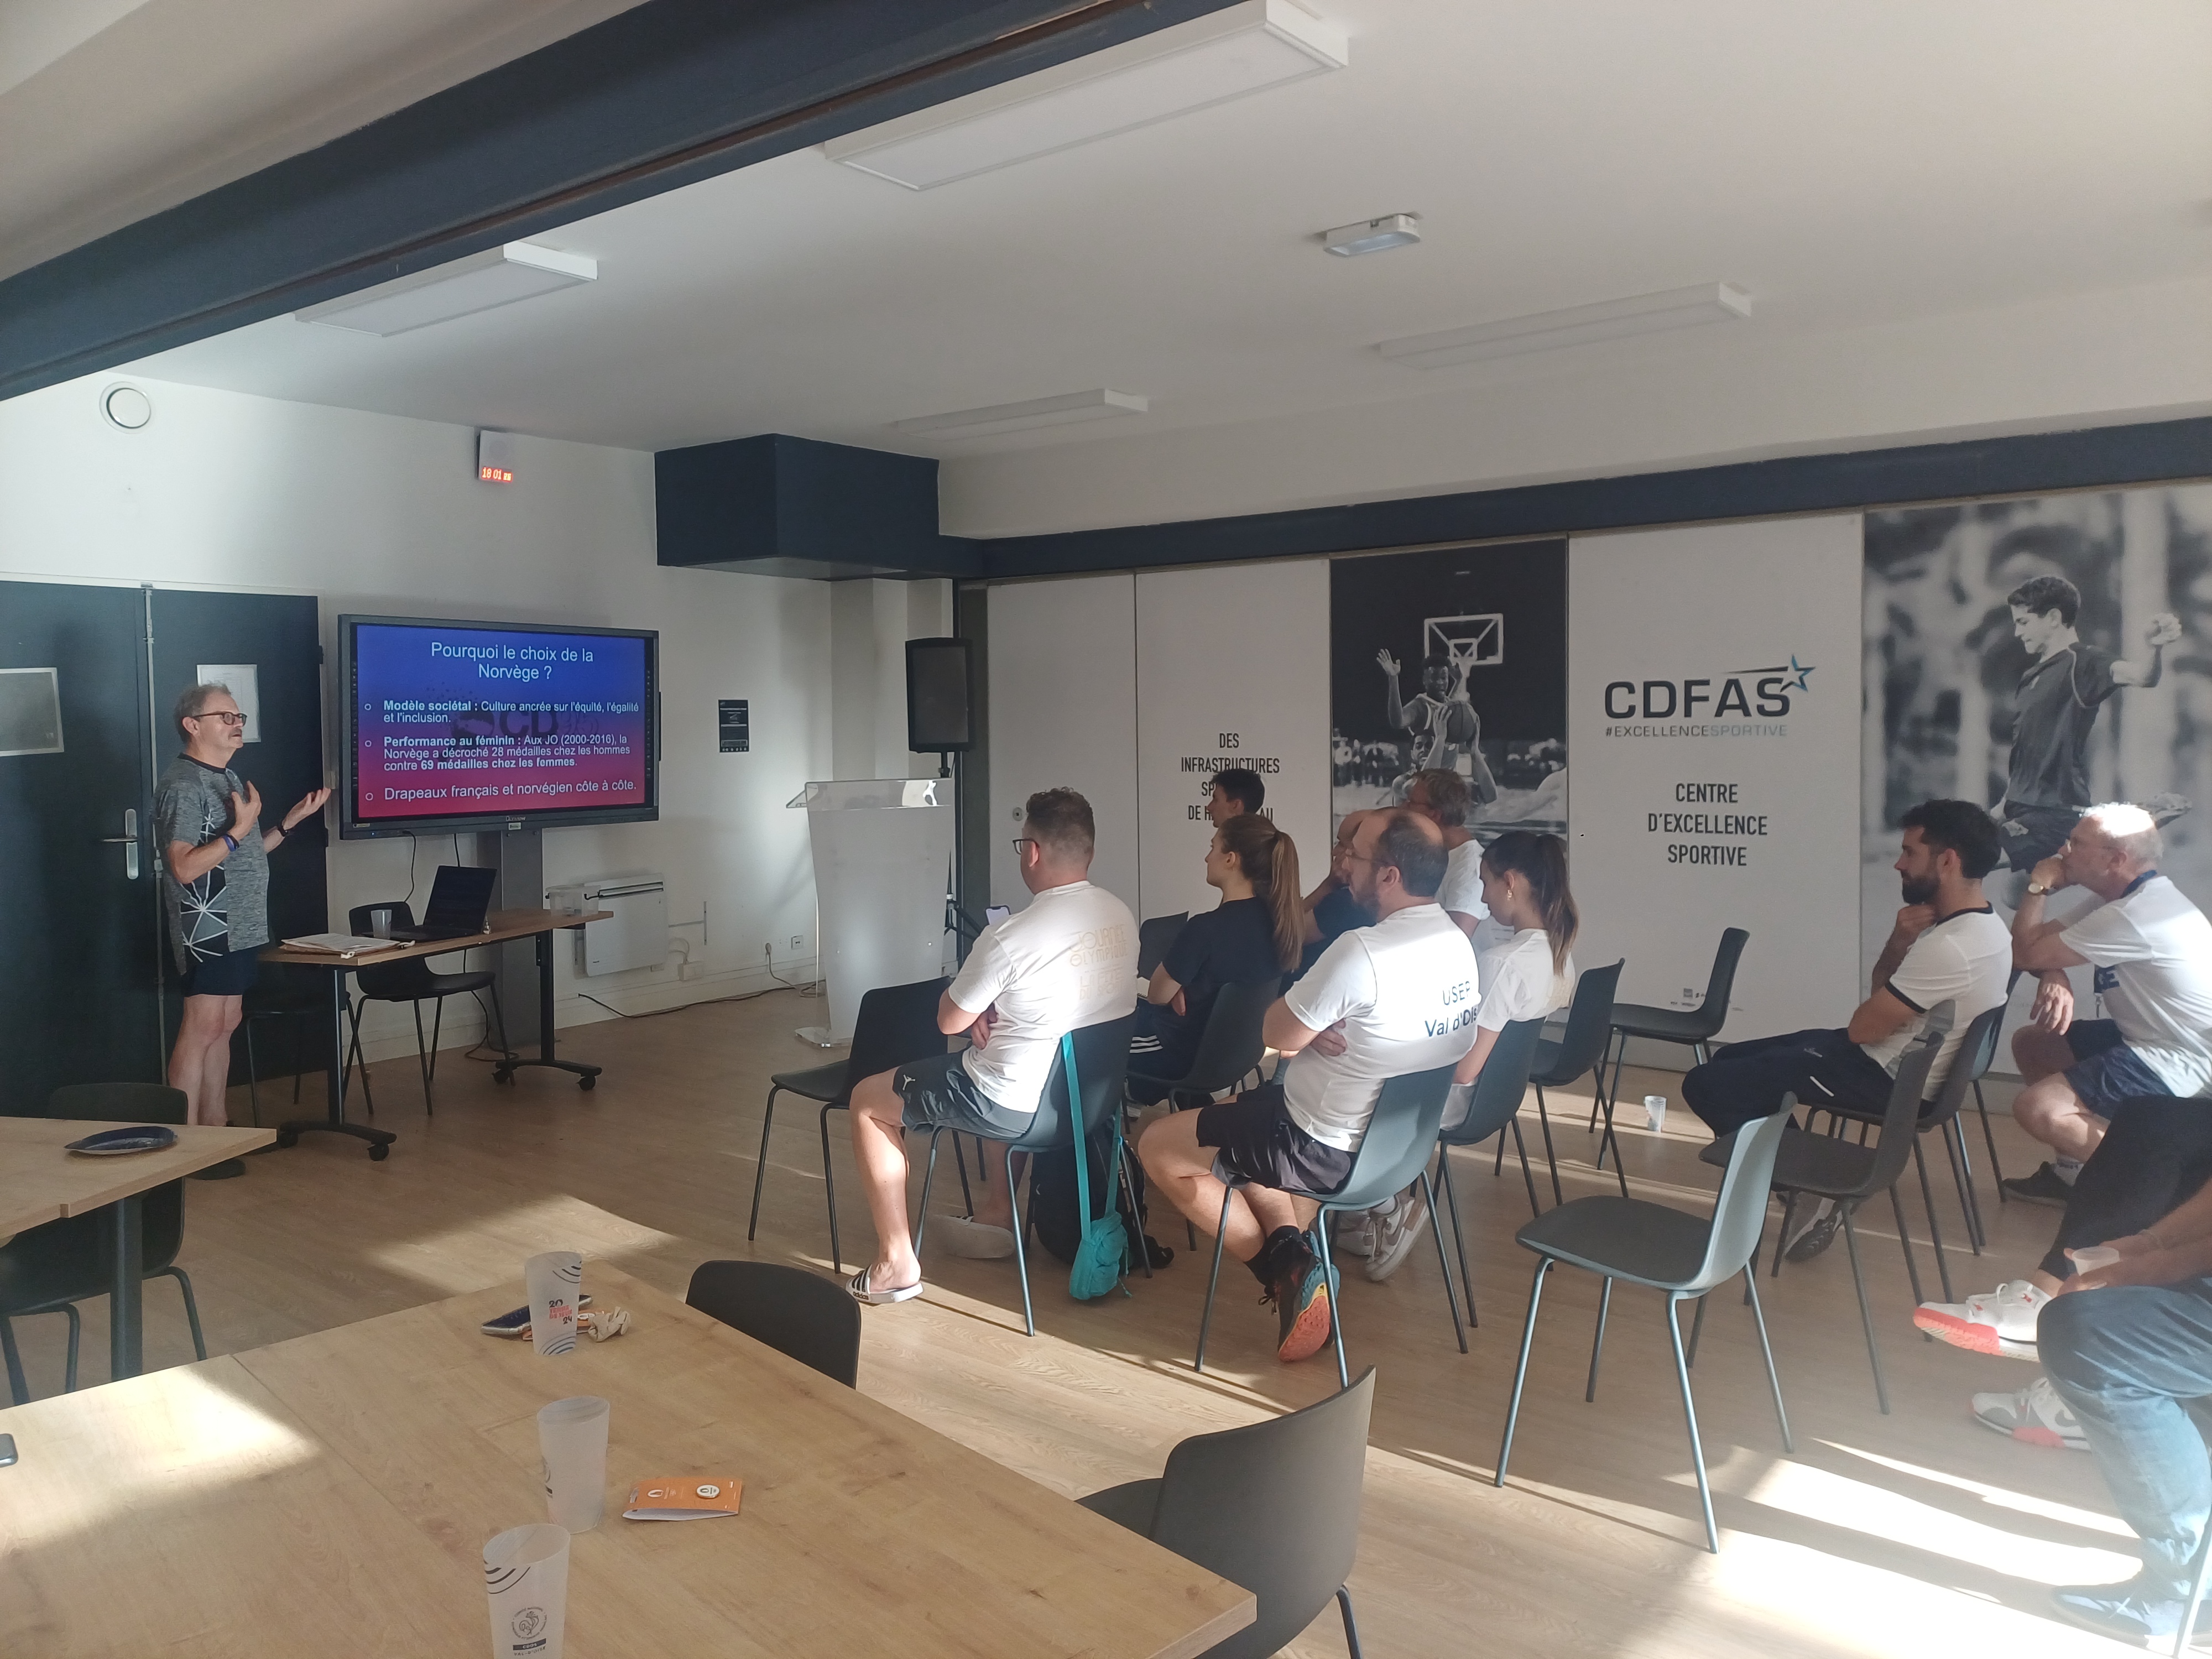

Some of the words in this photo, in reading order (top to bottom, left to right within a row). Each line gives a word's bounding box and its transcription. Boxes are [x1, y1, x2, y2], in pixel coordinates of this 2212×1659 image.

[431, 642, 498, 661] Pourquoi
[503, 645, 515, 660] le
[520, 646, 557, 660] choix
[561, 647, 578, 661] de
[582, 648, 593, 662] la
[478, 663, 539, 682] Norvège
[544, 665, 552, 679] ?
[1605, 677, 1791, 719] CDFAS
[384, 700, 425, 711] Modèle
[428, 701, 471, 711] sociétal
[481, 701, 516, 711] Culture
[519, 701, 551, 712] ancrée
[554, 703, 568, 712] sur
[571, 701, 604, 713] l'équité,
[607, 702, 639, 714] l'égalité
[384, 713, 394, 723] et
[397, 712, 451, 723] l'inclusion.
[1605, 723, 1787, 737] #EXCELLENCESPORTIVE
[384, 736, 456, 747] Performance
[476, 735, 514, 745] féminin
[524, 735, 542, 745] Aux
[545, 734, 558, 745] JO
[561, 734, 617, 746] (2000-2016),
[619, 734, 627, 744] la
[1219, 733, 1239, 748] DES
[384, 748, 429, 761] Norvège
[432, 750, 439, 758] a
[442, 747, 489, 758] décroché
[492, 747, 504, 757] 28
[507, 746, 551, 756] médailles
[554, 746, 576, 755] chez
[578, 746, 591, 755] les
[593, 745, 630, 755] hommes
[384, 760, 418, 771] contre
[421, 760, 434, 770] 69
[437, 759, 489, 770] médailles
[492, 758, 516, 768] chez
[519, 758, 534, 768] les
[536, 757, 577, 767] femmes.
[1181, 757, 1280, 773] INFRASTRUCTURES
[384, 787, 447, 802] Drapeaux
[451, 784, 499, 800] français
[502, 783, 514, 795] et
[517, 781, 572, 796] norvégien
[576, 780, 599, 792] côte
[602, 780, 608, 791] à
[612, 779, 637, 791] côte.
[1676, 783, 1738, 803] CENTRE
[1188, 805, 1201, 820] DE
[1648, 813, 1768, 835] D'EXCELLENCE
[1668, 844, 1747, 866] SPORTIVE
[1442, 980, 1470, 1005] USEP
[1425, 1018, 1449, 1037] Val
[1453, 1005, 1478, 1031] d'Ois
[549, 1299, 564, 1309] 20
[562, 1315, 572, 1325] 24
